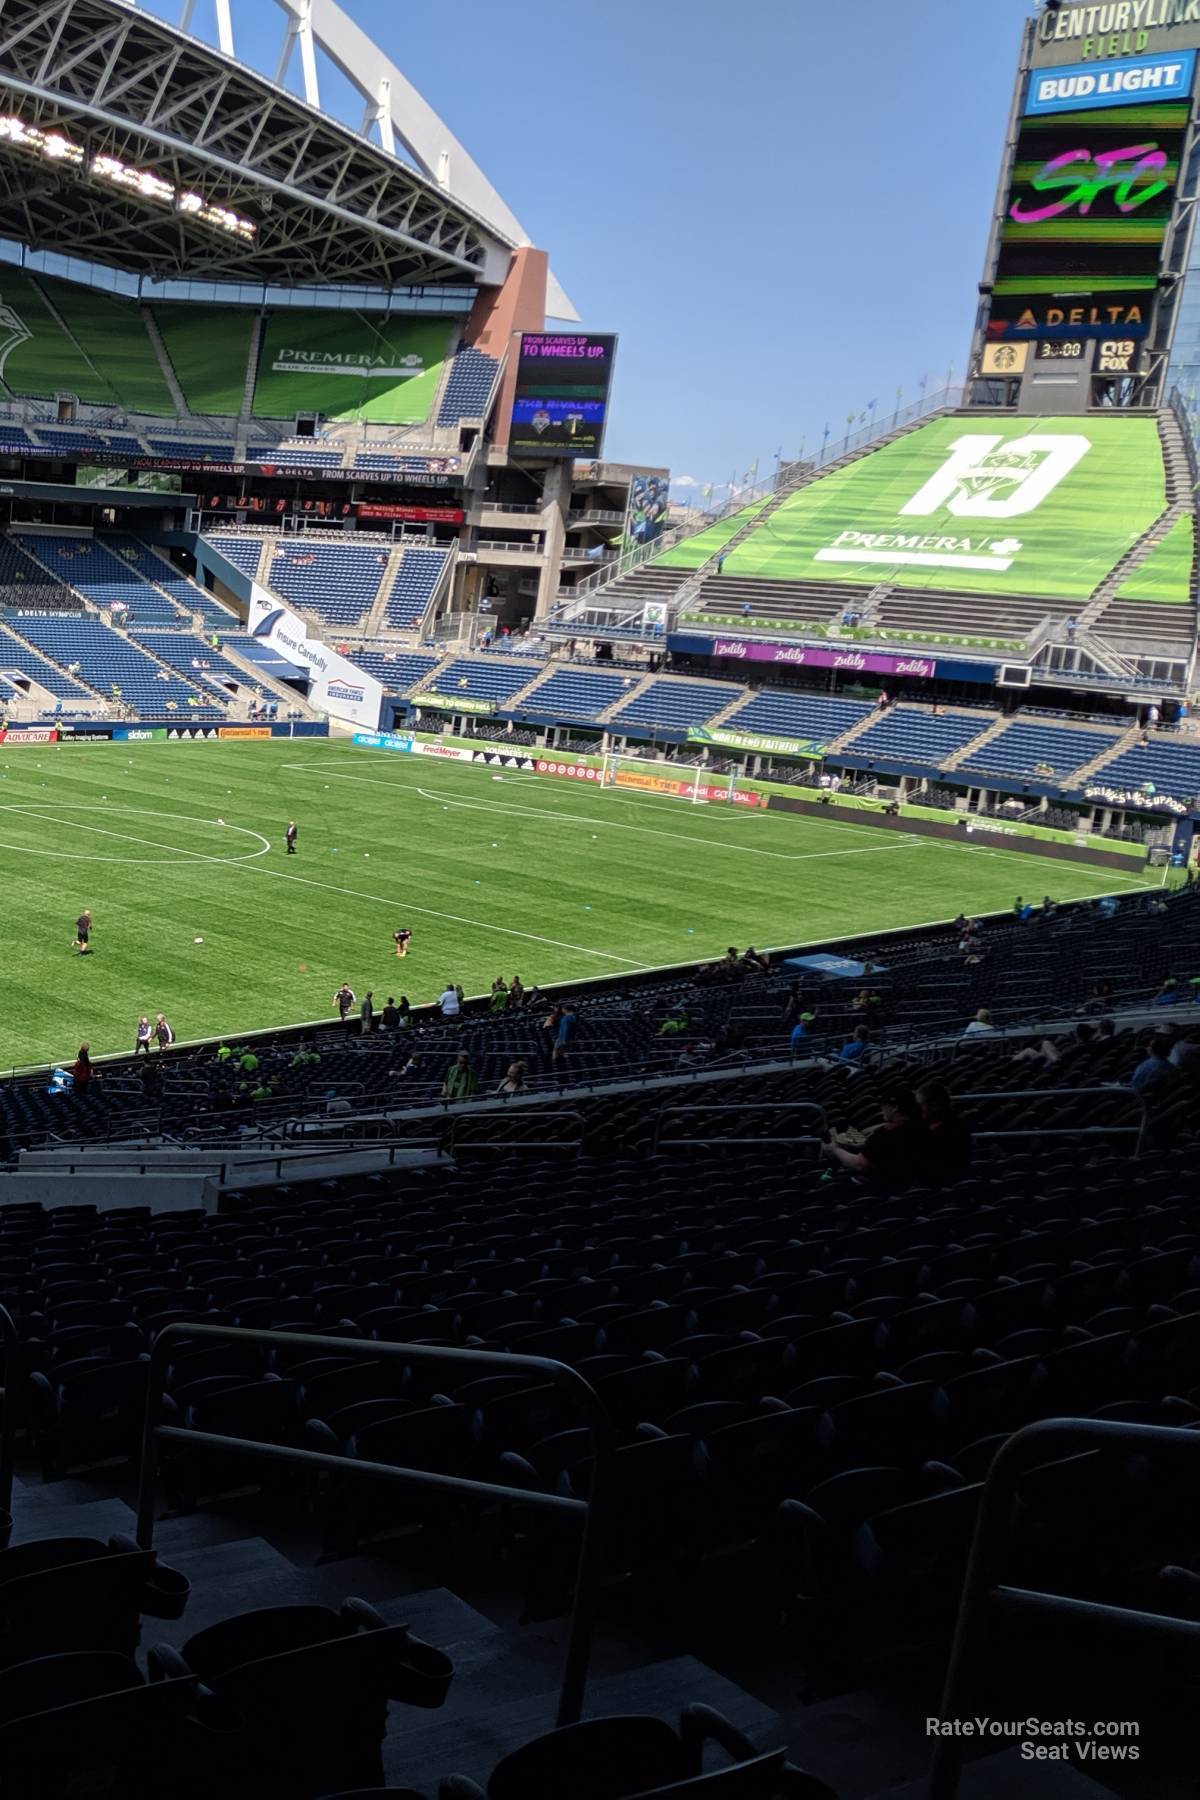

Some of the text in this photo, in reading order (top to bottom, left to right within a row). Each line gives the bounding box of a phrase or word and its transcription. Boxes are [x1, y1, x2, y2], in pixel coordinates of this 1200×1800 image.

[1040, 0, 1200, 42] CENTURYLINK
[1083, 31, 1149, 58] FIELD
[1038, 65, 1182, 100] BUD LIGHT
[1009, 142, 1169, 224] SFC
[1046, 306, 1142, 326] DELTA
[524, 345, 604, 358] TO WHEELS UP.
[1102, 341, 1135, 356] Q13
[278, 349, 386, 367] PREMERA
[1100, 356, 1130, 370] FOX
[518, 400, 600, 410] THE RIVALRY
[102, 455, 128, 463] DELTA
[203, 464, 246, 473] WHEELS UP.
[322, 470, 344, 479] FROM
[347, 472, 379, 480] SCARVES
[405, 474, 435, 484] WHEELS
[437, 476, 449, 484] UP.
[898, 434, 1092, 518] 10
[831, 531, 972, 551] PREMERA
[277, 629, 328, 672] Insure Carefully
[414, 697, 444, 706] WELCOME
[6, 732, 50, 742] ADVOCARE
[127, 730, 153, 739] slalom
[220, 728, 251, 738] Continental
[712, 733, 799, 752] NORTH END FAITHFUL
[485, 746, 522, 757] SOUNDERS
